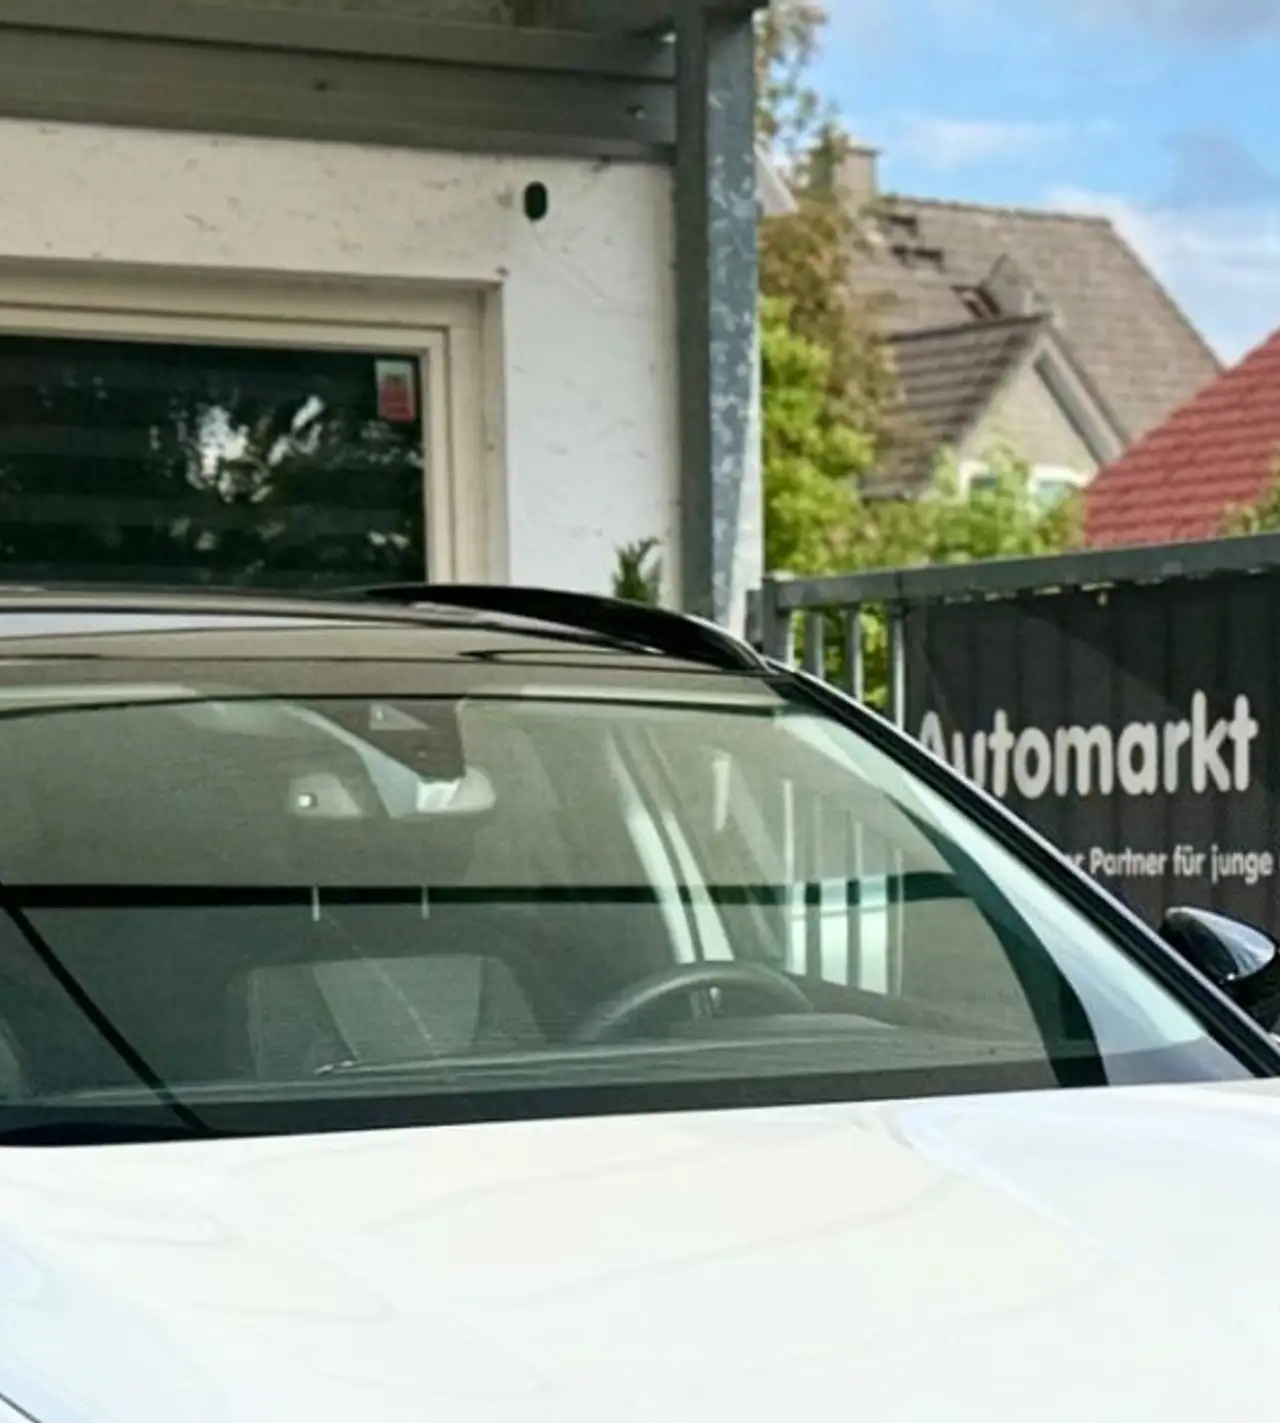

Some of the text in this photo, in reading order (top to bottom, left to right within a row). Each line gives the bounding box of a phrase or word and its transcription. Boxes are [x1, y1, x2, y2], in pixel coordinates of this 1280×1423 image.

[1090, 847, 1166, 876] Partner
[1173, 844, 1205, 876] für
[1211, 844, 1272, 884] junge
